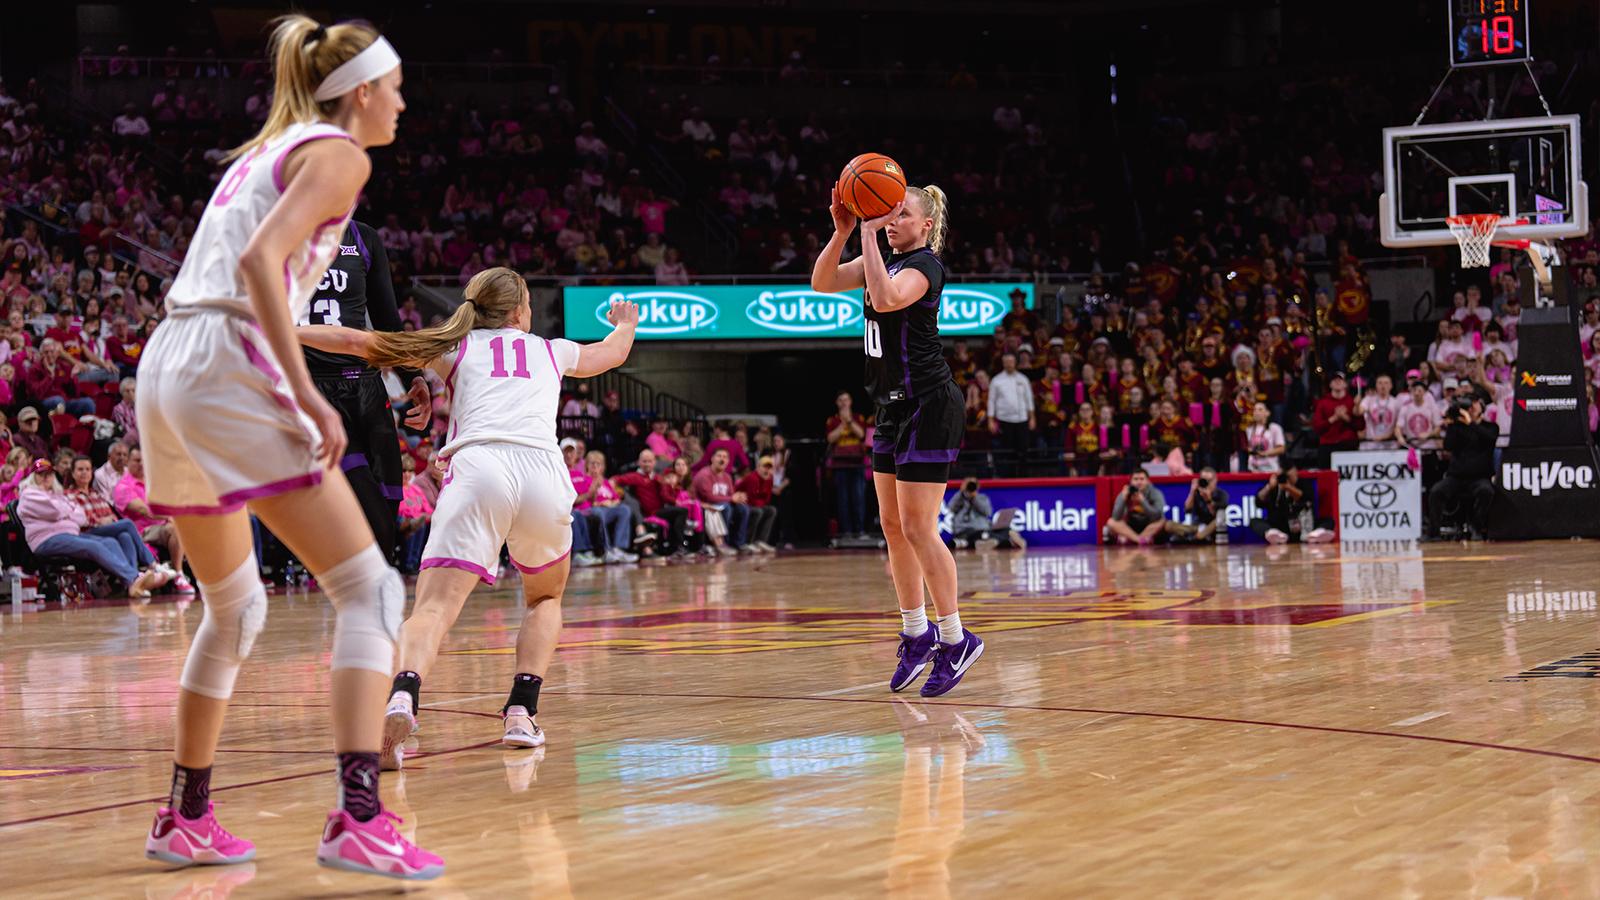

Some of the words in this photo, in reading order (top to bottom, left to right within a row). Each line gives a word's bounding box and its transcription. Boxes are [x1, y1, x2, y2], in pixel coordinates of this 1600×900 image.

[1481, 16, 1514, 54] 18
[317, 268, 349, 293] CU
[758, 291, 853, 327] Sukup
[943, 296, 995, 326] kup
[489, 336, 531, 379] 11
[1337, 463, 1415, 481] WILSON
[993, 500, 1095, 532] ellular
[1341, 512, 1412, 529] TOYOTA
